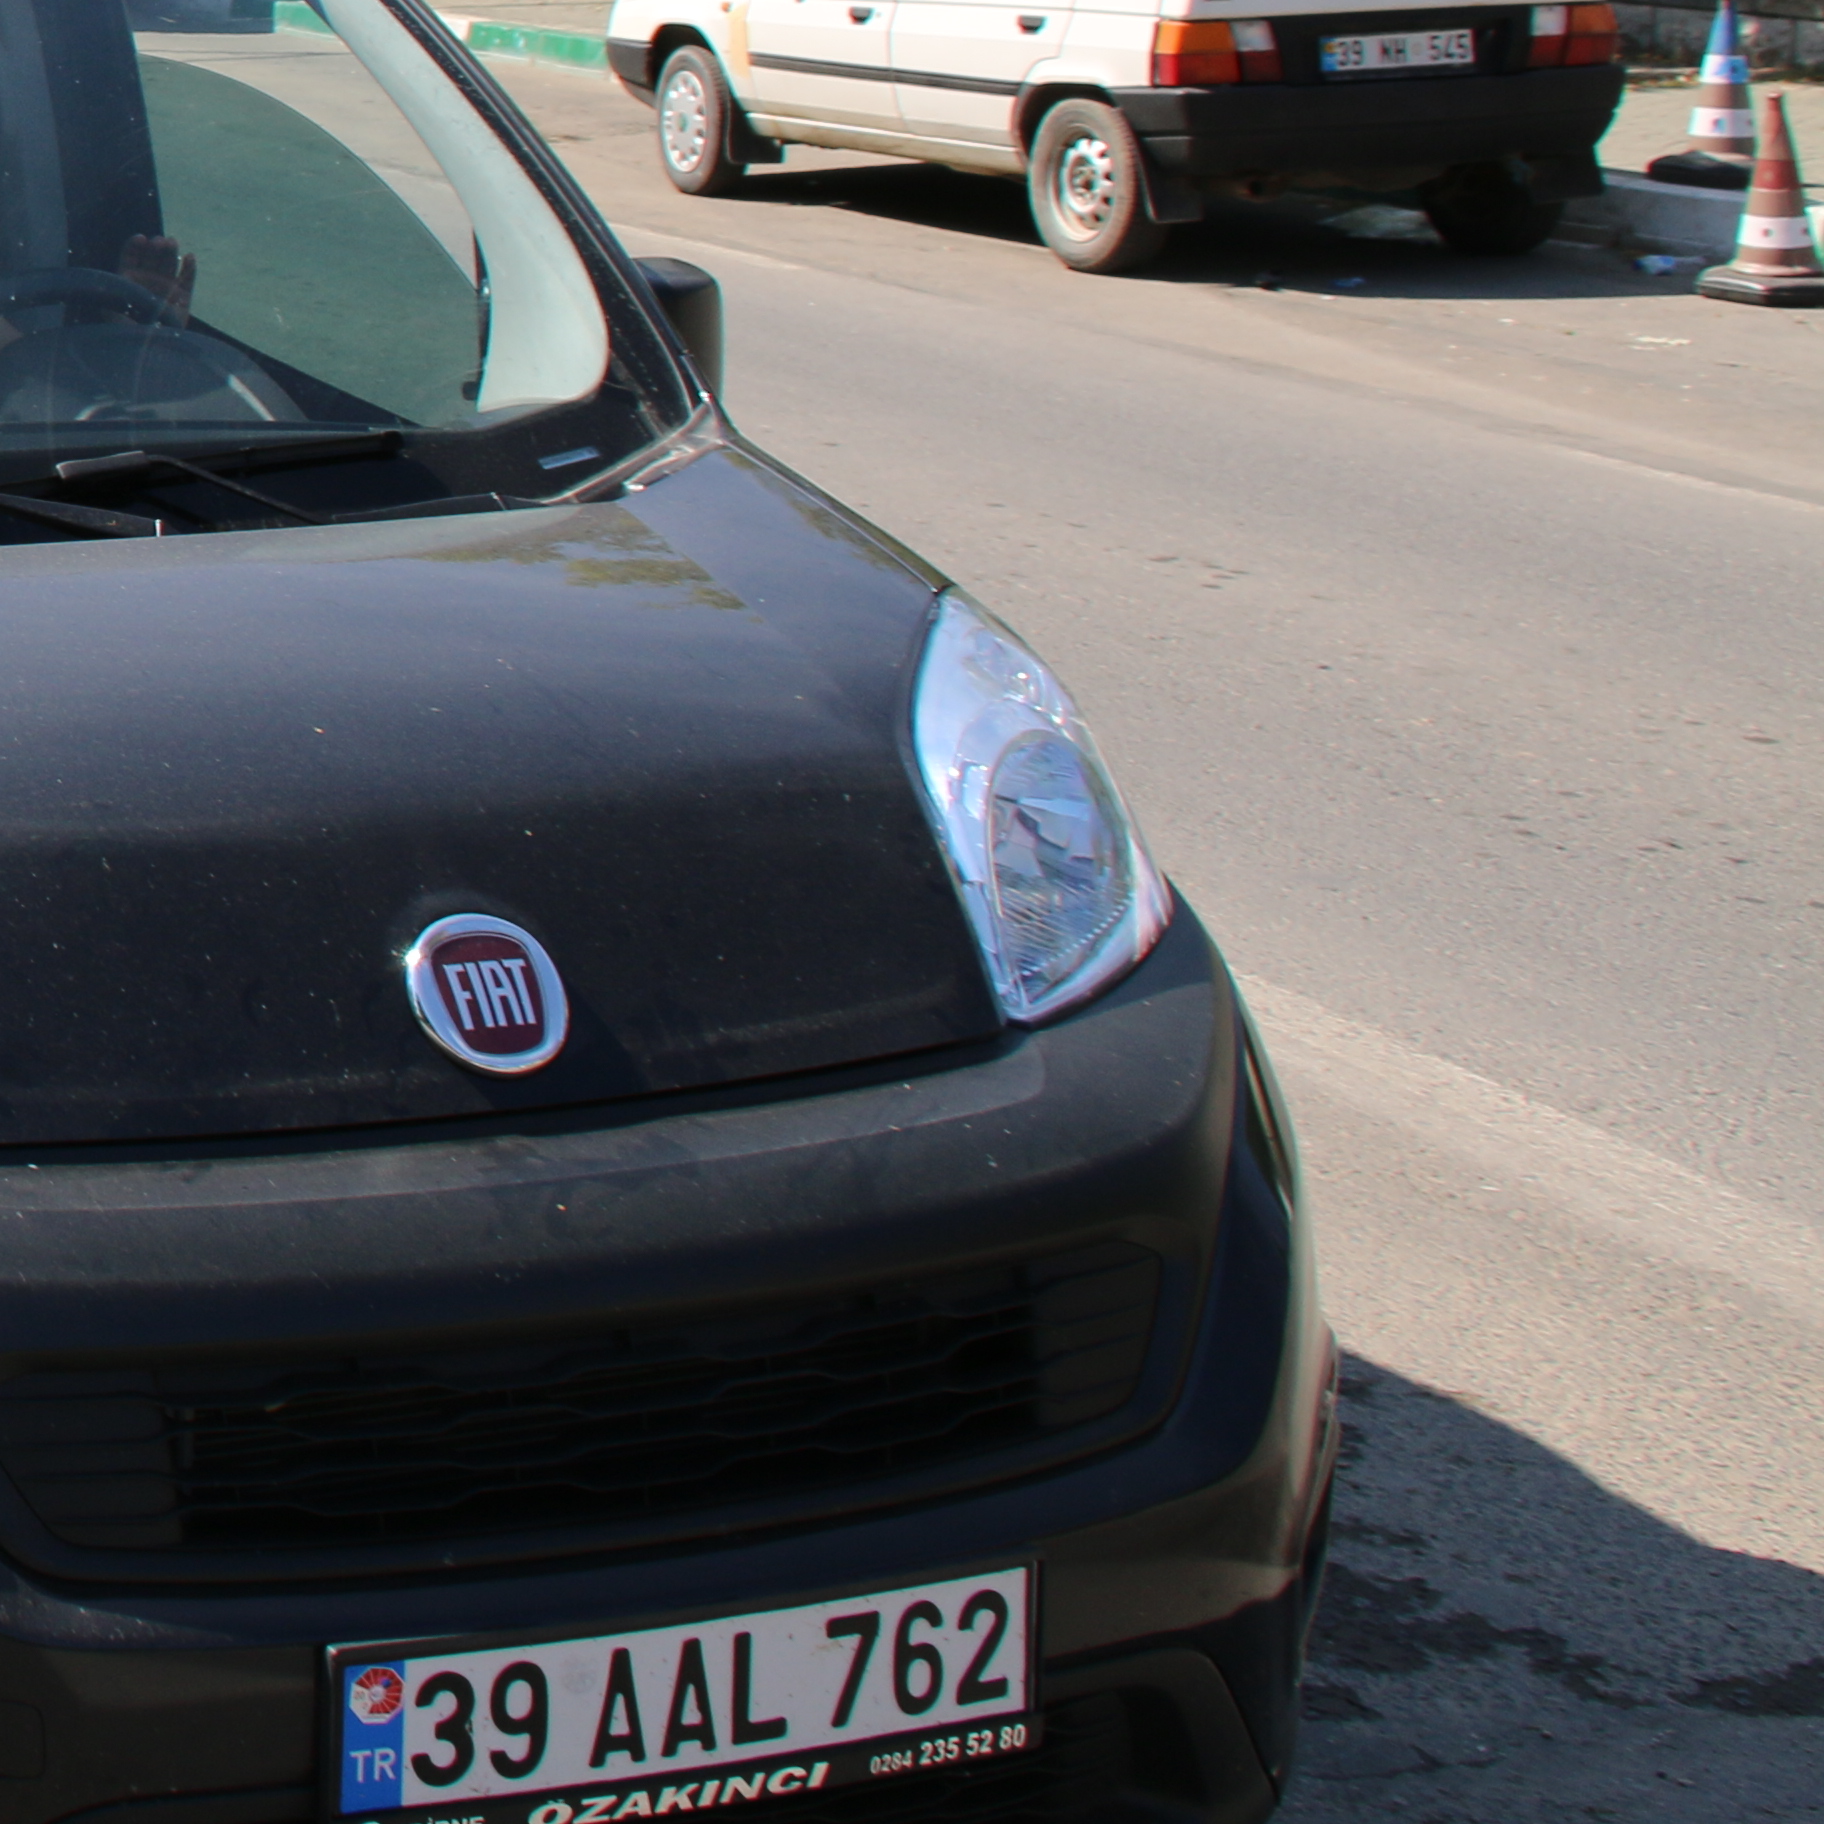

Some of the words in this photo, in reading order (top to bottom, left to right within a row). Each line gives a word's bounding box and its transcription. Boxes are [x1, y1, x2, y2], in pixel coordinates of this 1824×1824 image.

[1336, 39, 1364, 67] 39
[1428, 33, 1470, 62] 545
[442, 958, 538, 1031] FIAT
[409, 1660, 549, 1787] 39
[588, 1630, 788, 1768] AAL
[825, 1588, 1010, 1729] 762
[349, 1746, 397, 1784] TR
[869, 1752, 913, 1776] 0284
[918, 1736, 960, 1767] 235
[965, 1729, 994, 1754] 52
[998, 1723, 1027, 1749] 80
[526, 1760, 831, 1824] ÖZAKINCI
